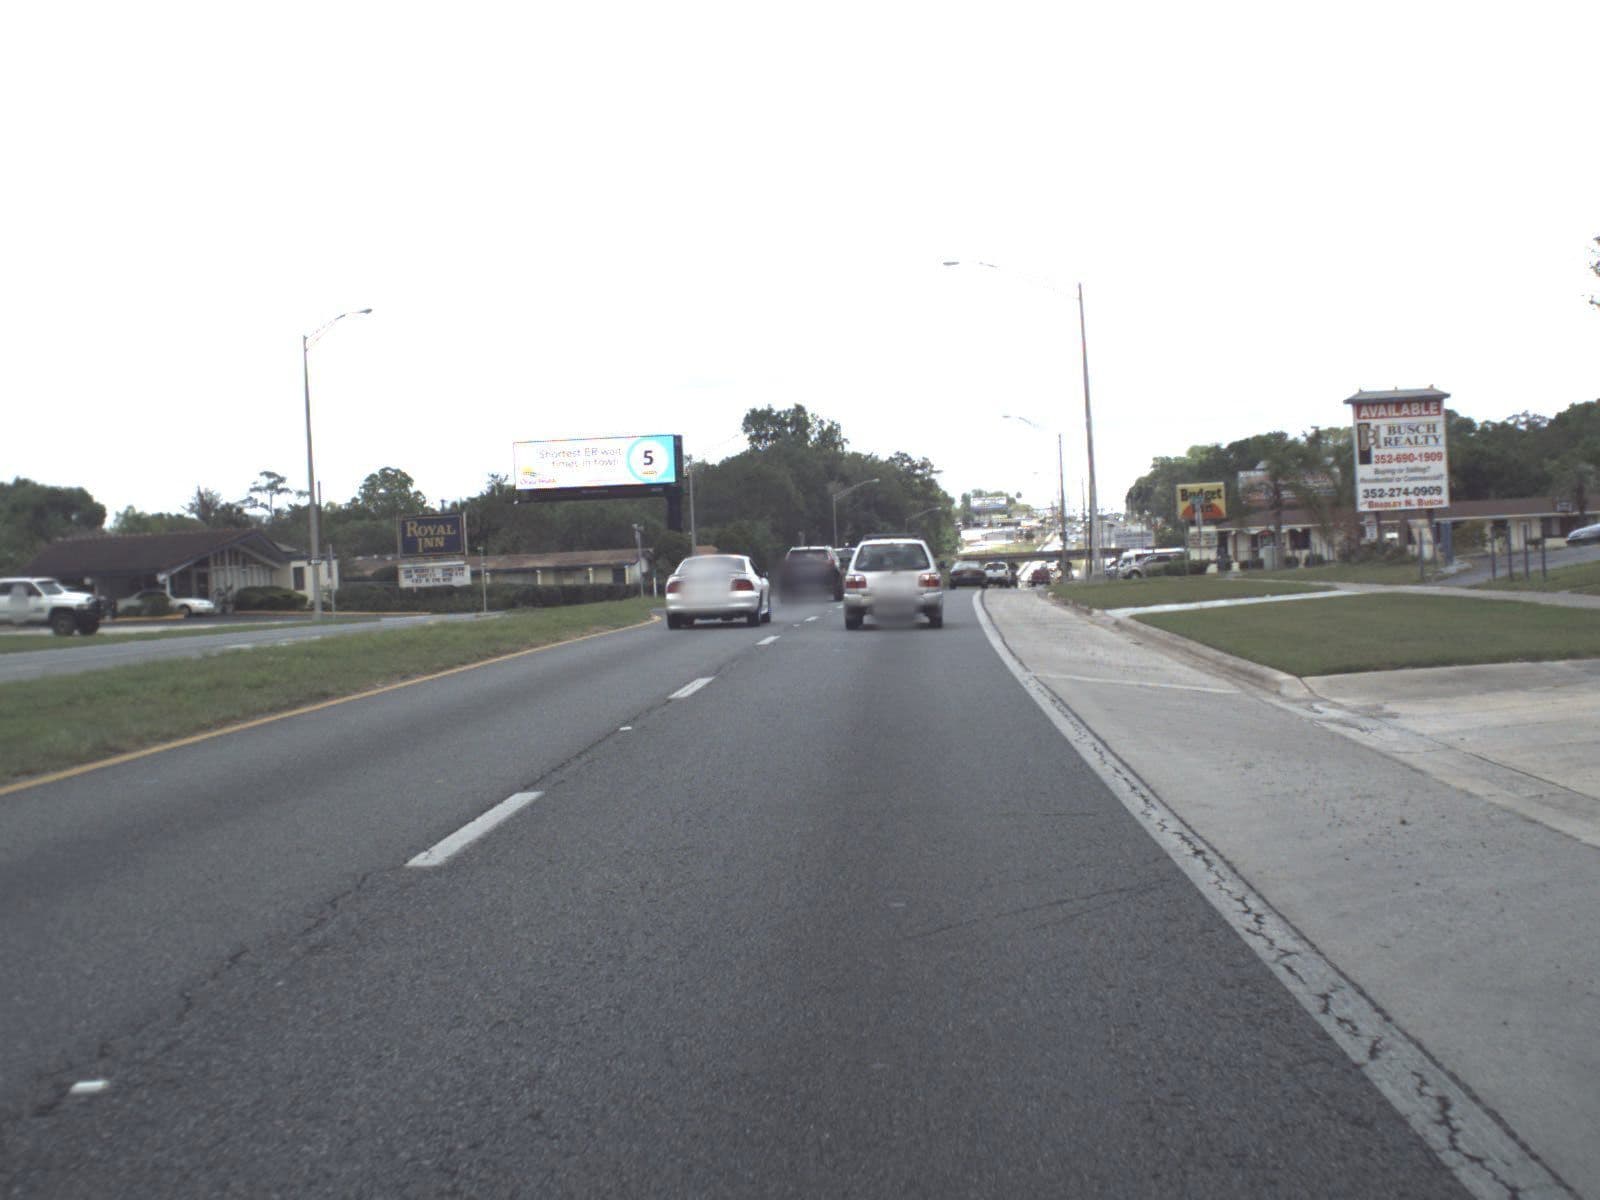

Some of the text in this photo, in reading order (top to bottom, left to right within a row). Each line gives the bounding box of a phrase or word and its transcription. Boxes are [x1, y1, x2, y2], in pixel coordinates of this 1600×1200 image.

[1360, 402, 1439, 417] AVAILABLE
[1388, 424, 1437, 435] BUSCH
[1384, 435, 1440, 446] REALTY
[539, 448, 622, 459] Shortest ER wait
[643, 450, 654, 466] 5
[1374, 453, 1443, 464] 352-690-1909
[1363, 486, 1442, 498] 352-274-0909
